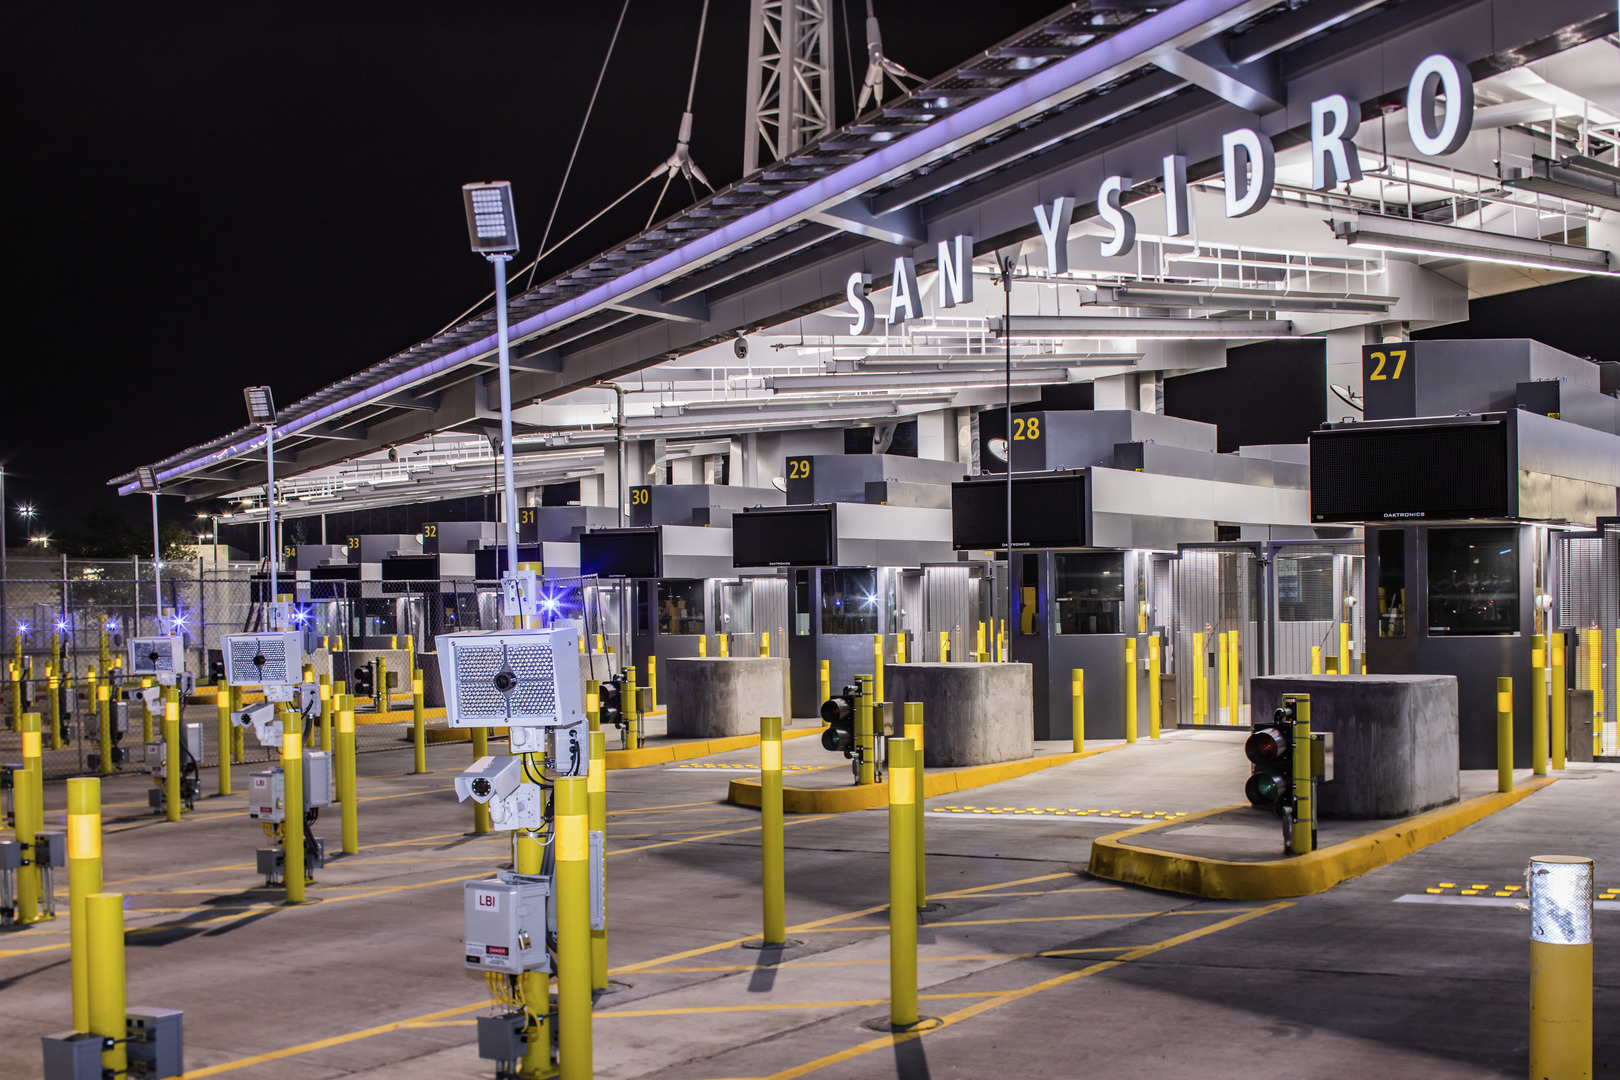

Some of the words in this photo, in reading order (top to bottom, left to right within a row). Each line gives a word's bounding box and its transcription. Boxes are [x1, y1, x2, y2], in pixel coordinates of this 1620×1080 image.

[846, 234, 973, 336] SAN
[1033, 54, 1474, 274] YSIDRO
[1370, 349, 1407, 381] 27
[1013, 417, 1040, 441] 28
[789, 460, 810, 479] 29
[632, 489, 649, 505] 30
[521, 510, 534, 524] 31
[424, 525, 436, 538] 32
[348, 538, 360, 549] 33
[285, 547, 296, 558] 34
[479, 895, 495, 907] LBI
